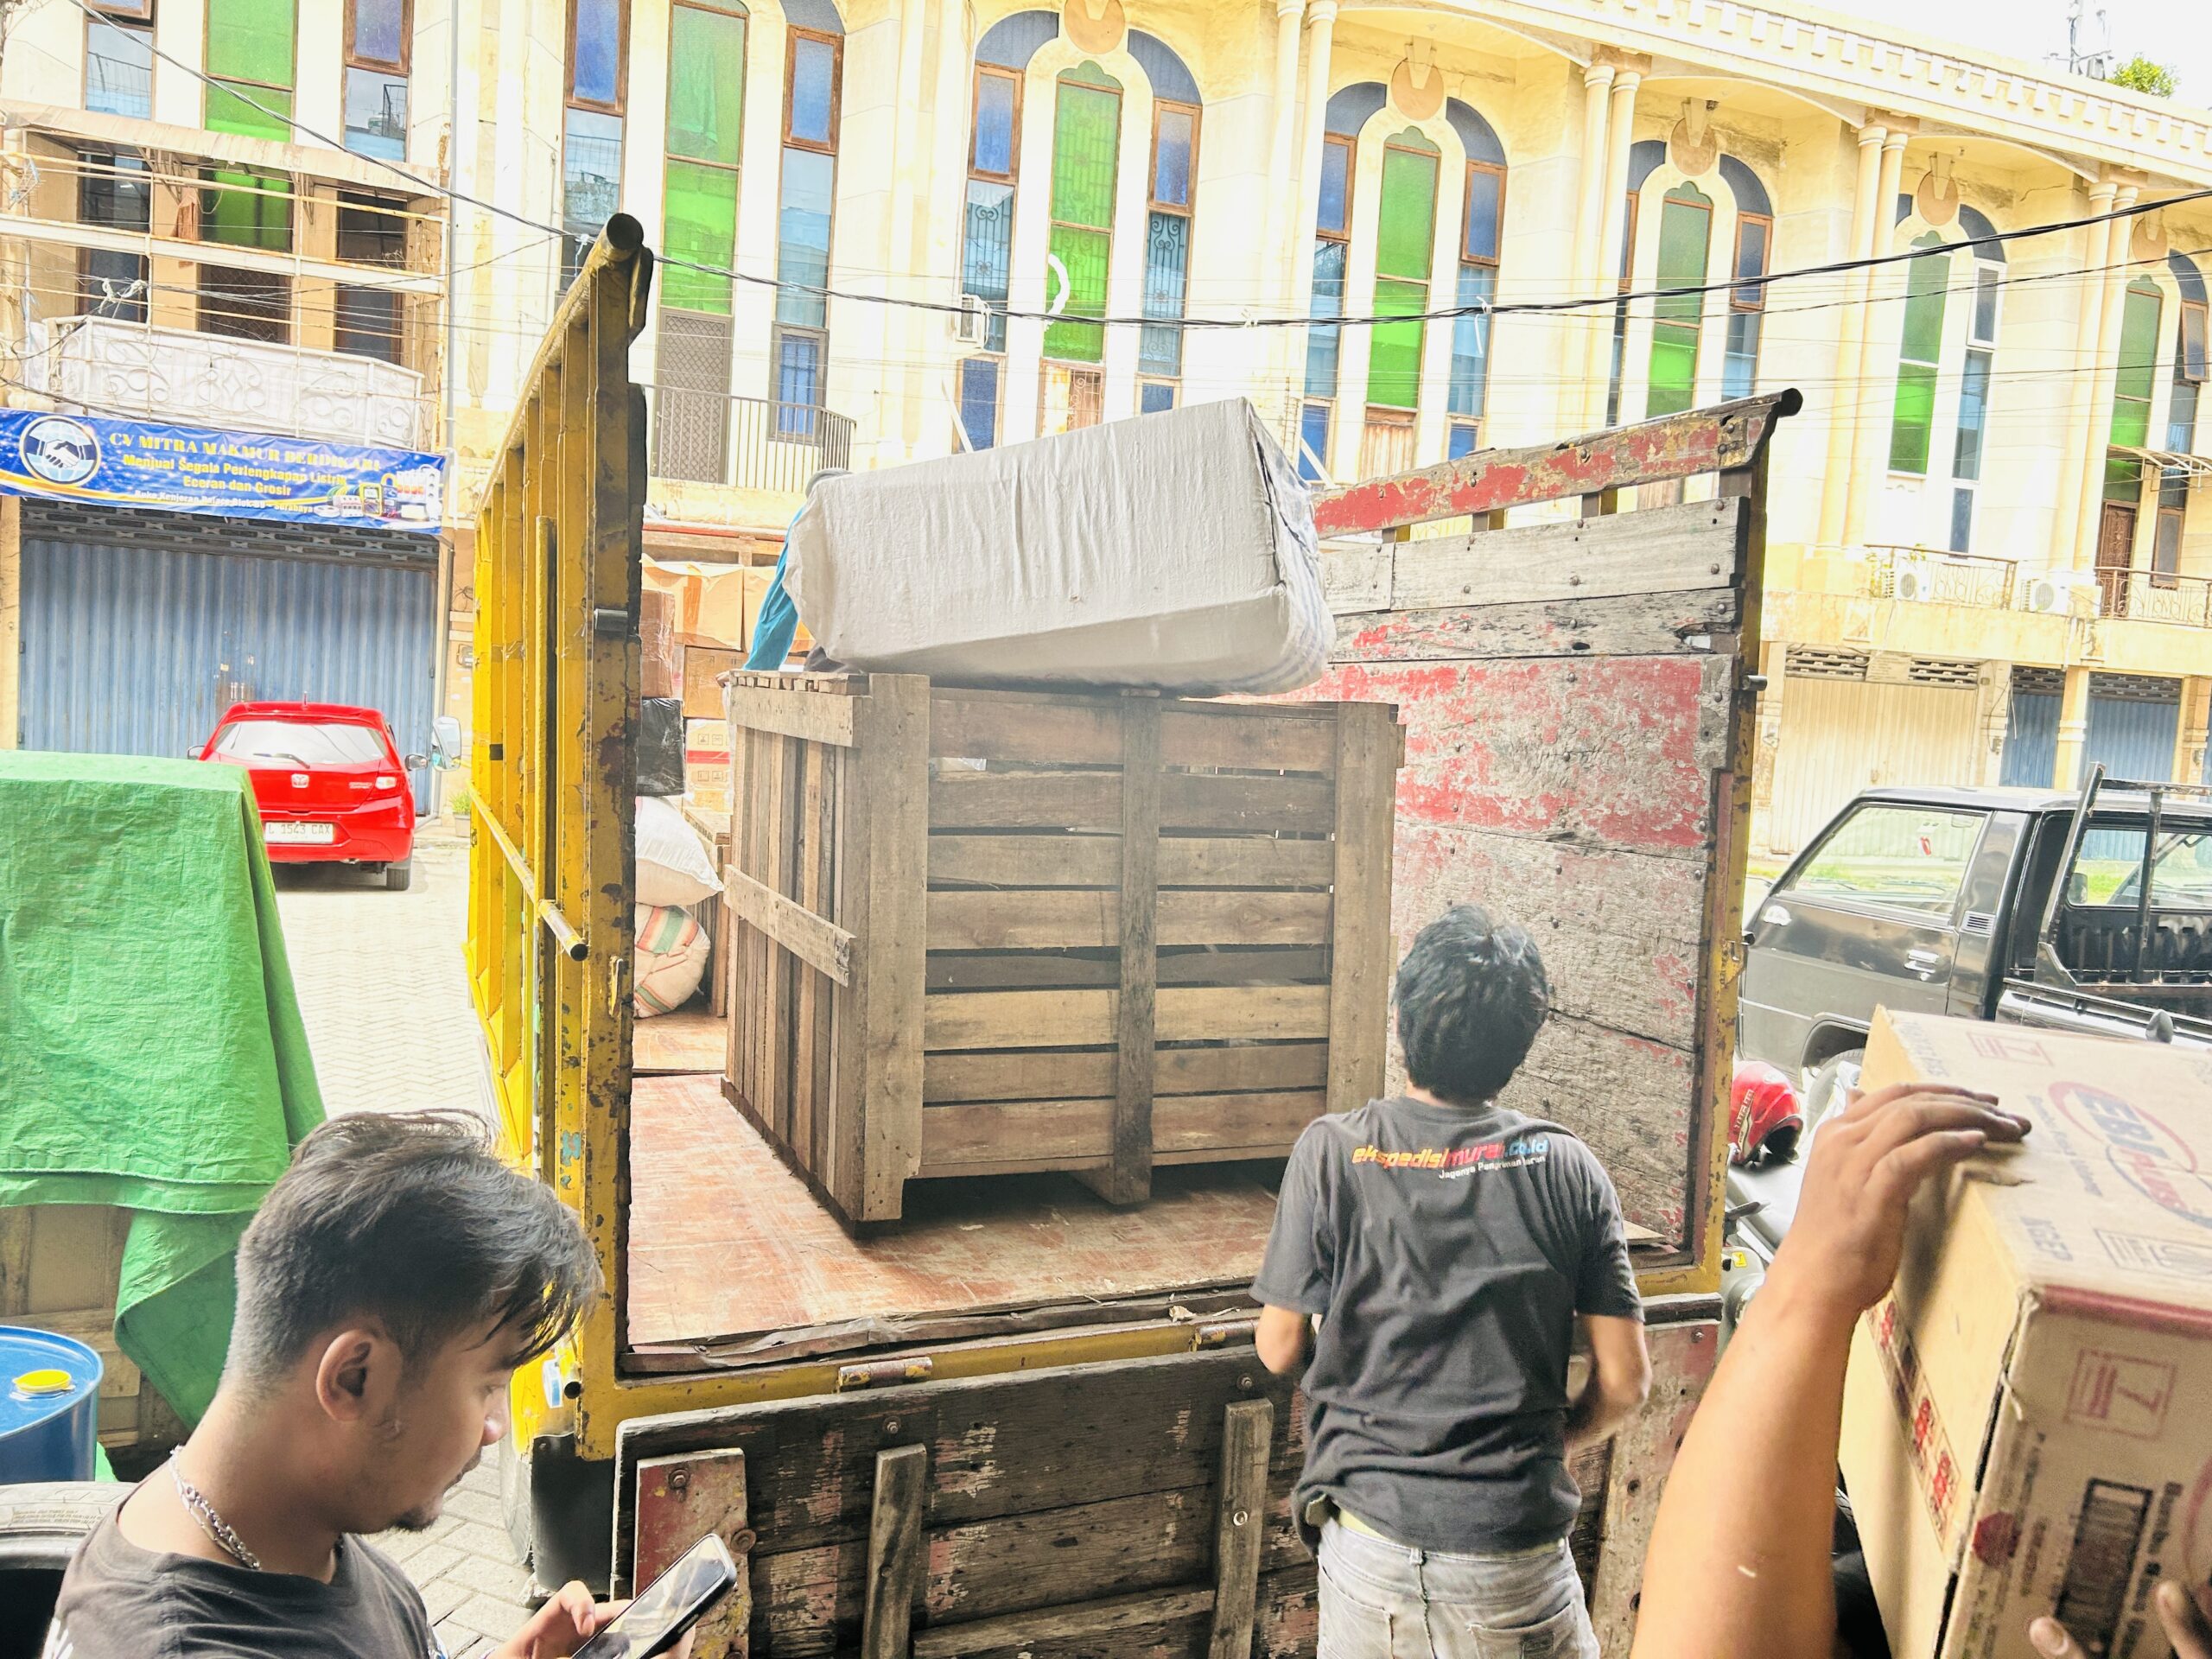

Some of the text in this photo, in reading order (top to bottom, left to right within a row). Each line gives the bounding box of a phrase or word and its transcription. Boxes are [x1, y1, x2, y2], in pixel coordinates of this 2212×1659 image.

[110, 432, 135, 447] CV
[138, 435, 199, 454] MITRA
[202, 442, 281, 462] MAKMUR
[123, 454, 175, 471] Menjual
[178, 458, 220, 475] Segala
[223, 462, 308, 483] Perlengkapan
[182, 475, 292, 496] Eceran dan Grosir
[268, 823, 276, 835] L
[311, 824, 331, 836] CAX
[1439, 1166, 1476, 1179] Jagonya
